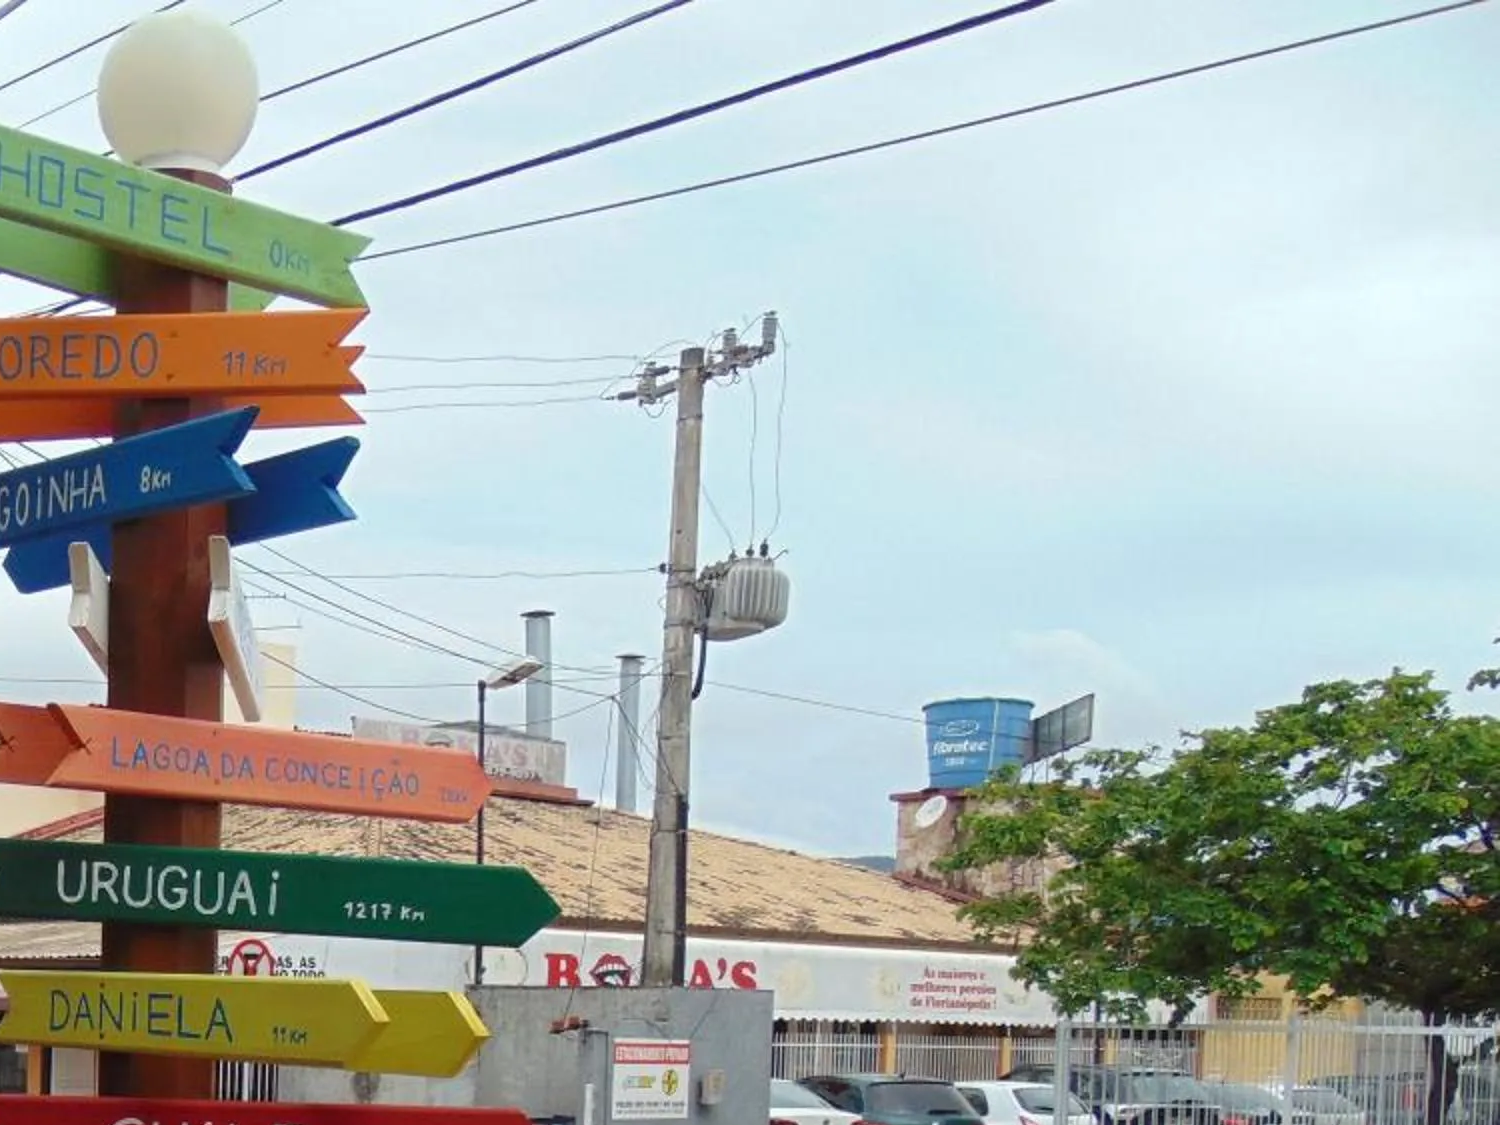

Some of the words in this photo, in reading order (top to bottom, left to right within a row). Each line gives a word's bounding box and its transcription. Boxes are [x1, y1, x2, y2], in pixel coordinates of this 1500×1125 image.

[111, 735, 211, 777] LAGOA
[220, 753, 255, 781] DA
[343, 901, 392, 920] 1217
